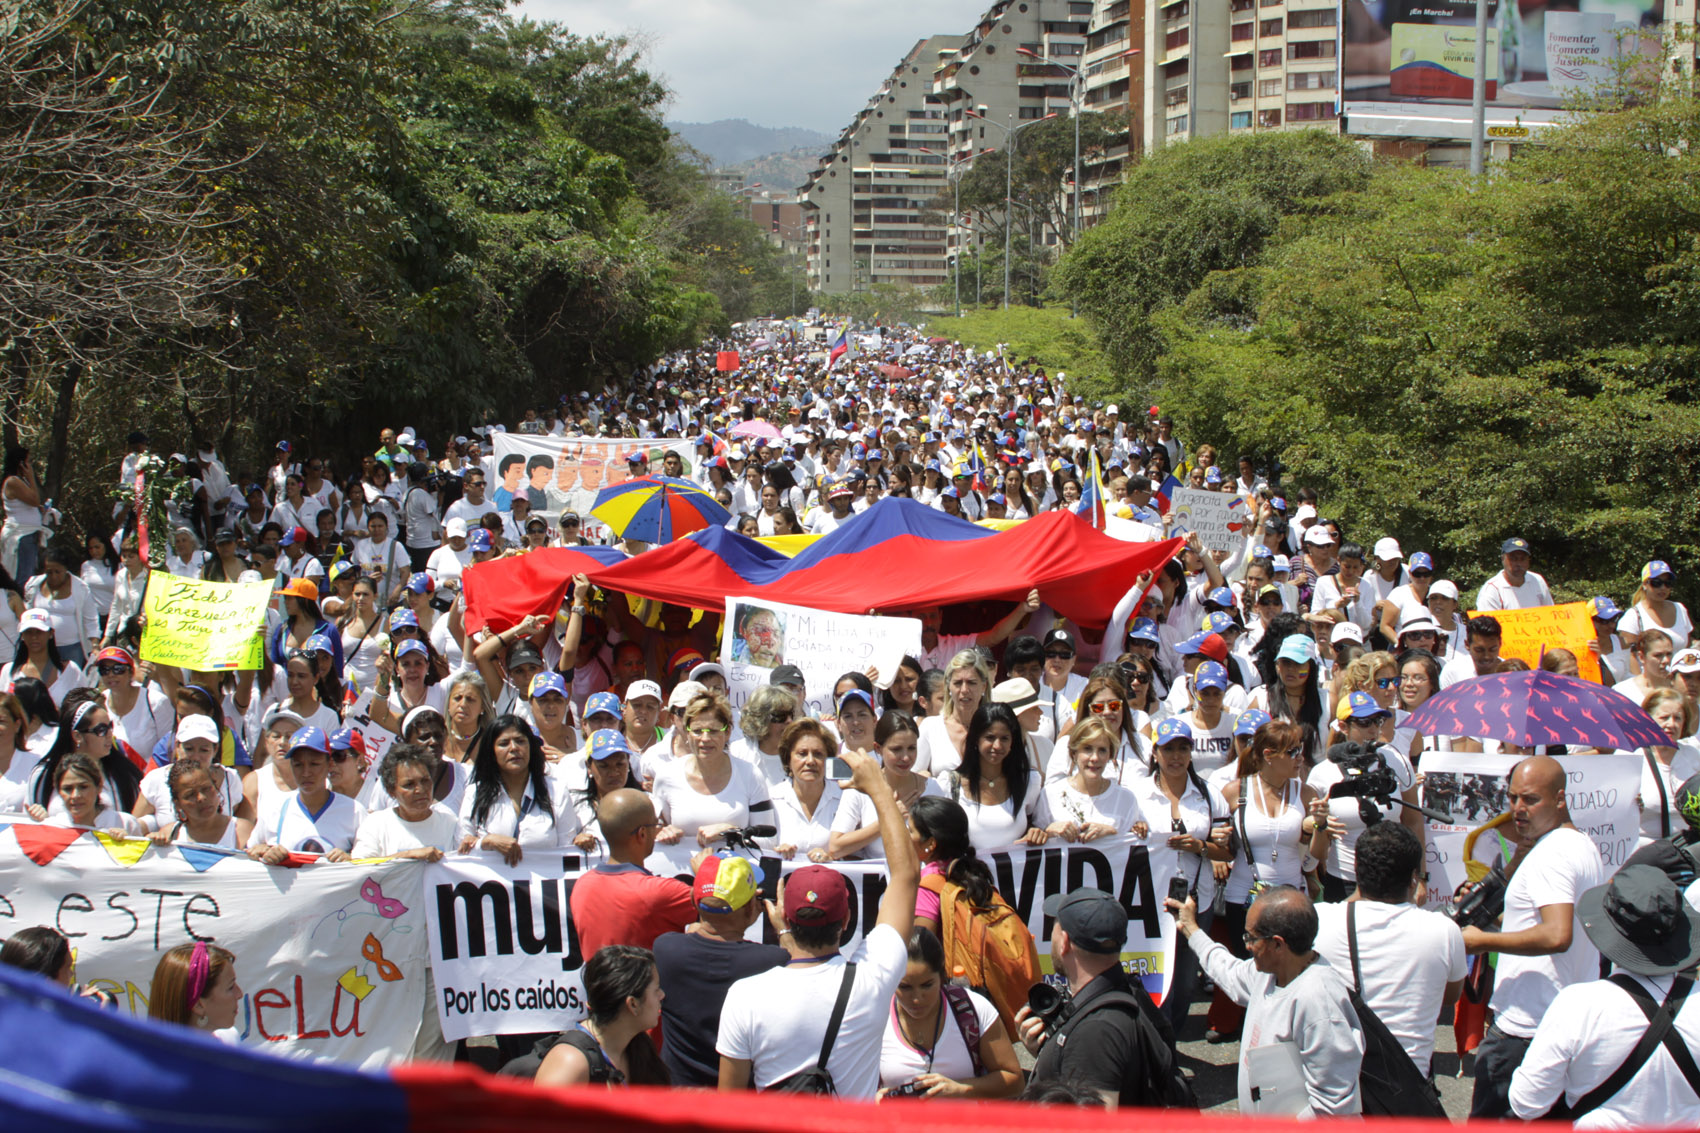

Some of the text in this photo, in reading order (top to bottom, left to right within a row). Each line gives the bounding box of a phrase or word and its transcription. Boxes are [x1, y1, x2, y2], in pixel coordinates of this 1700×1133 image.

[1423, 9, 1454, 17] Marcha!
[1549, 32, 1596, 44] Fomentar
[1554, 44, 1600, 54] Comercio
[168, 582, 232, 603] Fidel
[1568, 771, 1584, 784] TO
[1565, 788, 1618, 810] OLDADO
[991, 845, 1162, 942] VIDA
[443, 978, 584, 1017] Por los caídos,
